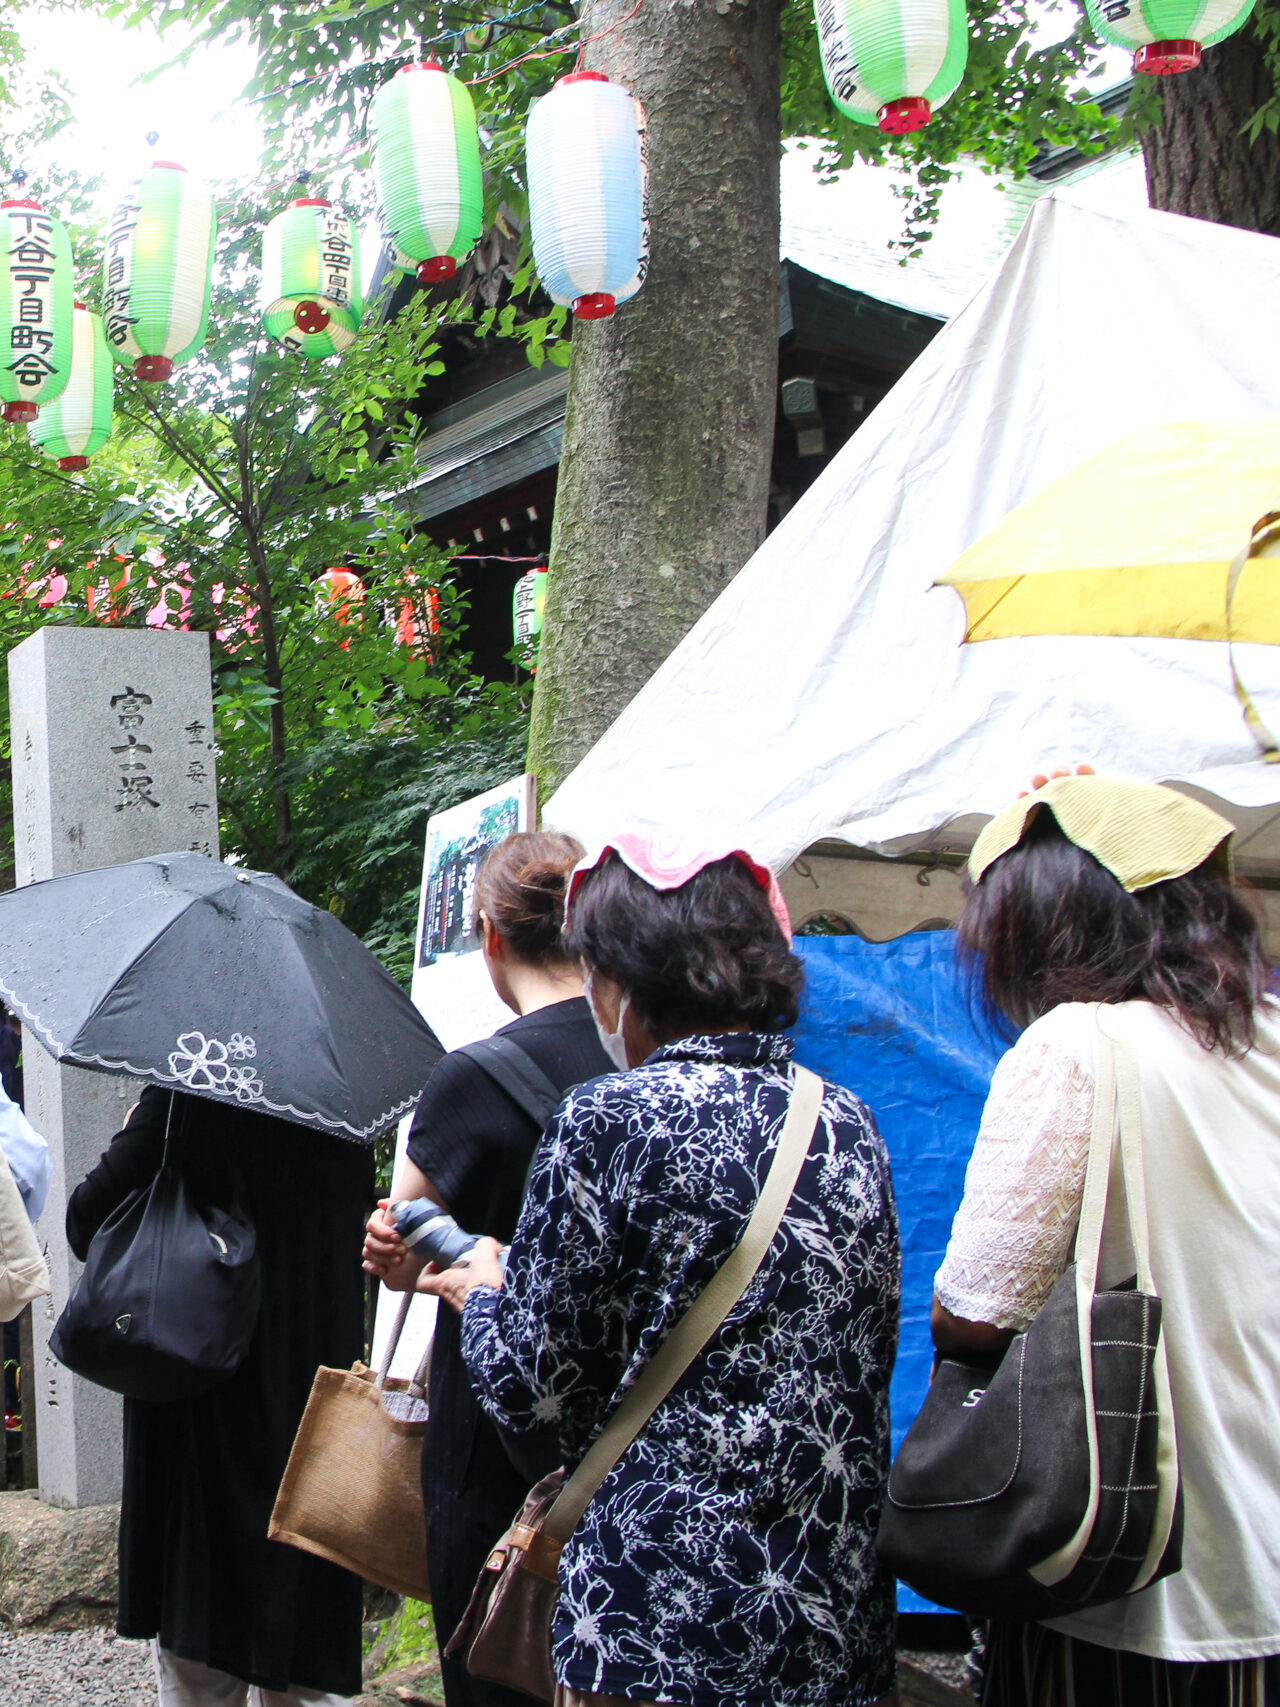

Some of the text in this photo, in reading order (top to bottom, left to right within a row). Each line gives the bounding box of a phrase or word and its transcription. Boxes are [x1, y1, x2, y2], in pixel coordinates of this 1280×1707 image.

[6, 213, 58, 386] 下谷一丁目町会
[110, 686, 160, 813] 富士塚
